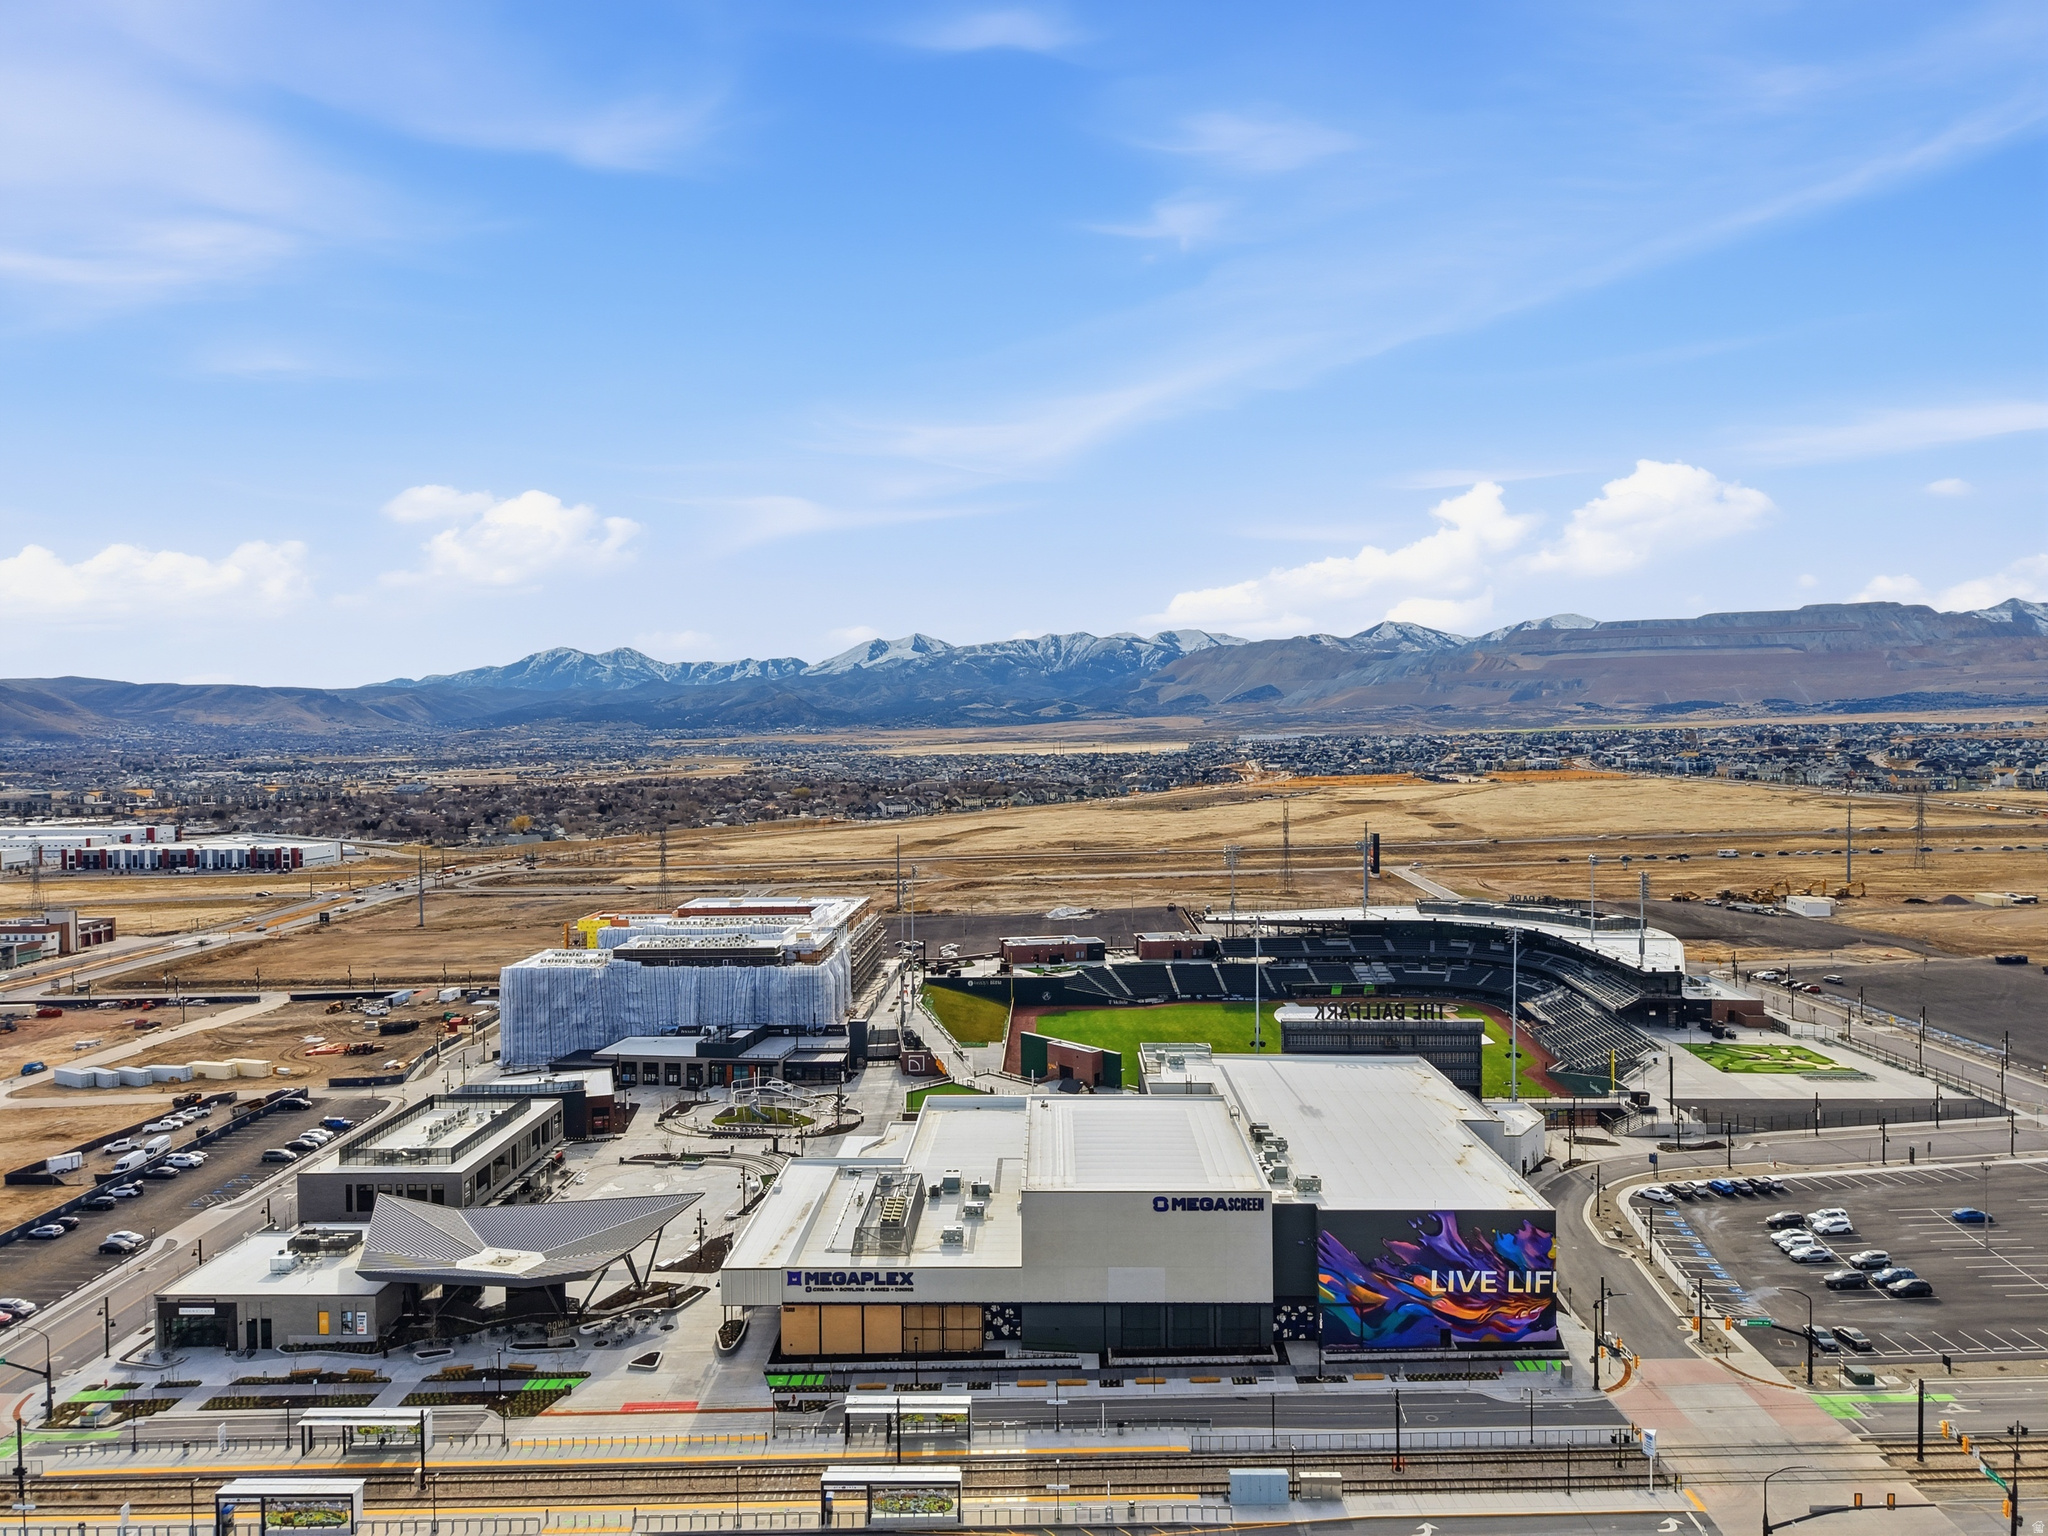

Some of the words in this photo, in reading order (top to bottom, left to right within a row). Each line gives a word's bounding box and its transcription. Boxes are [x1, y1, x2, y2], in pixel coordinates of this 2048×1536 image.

[1171, 1197, 1265, 1212] MEGASCREEN
[804, 1272, 914, 1286] MEGAPLEX
[1431, 1270, 1498, 1293] LIVE
